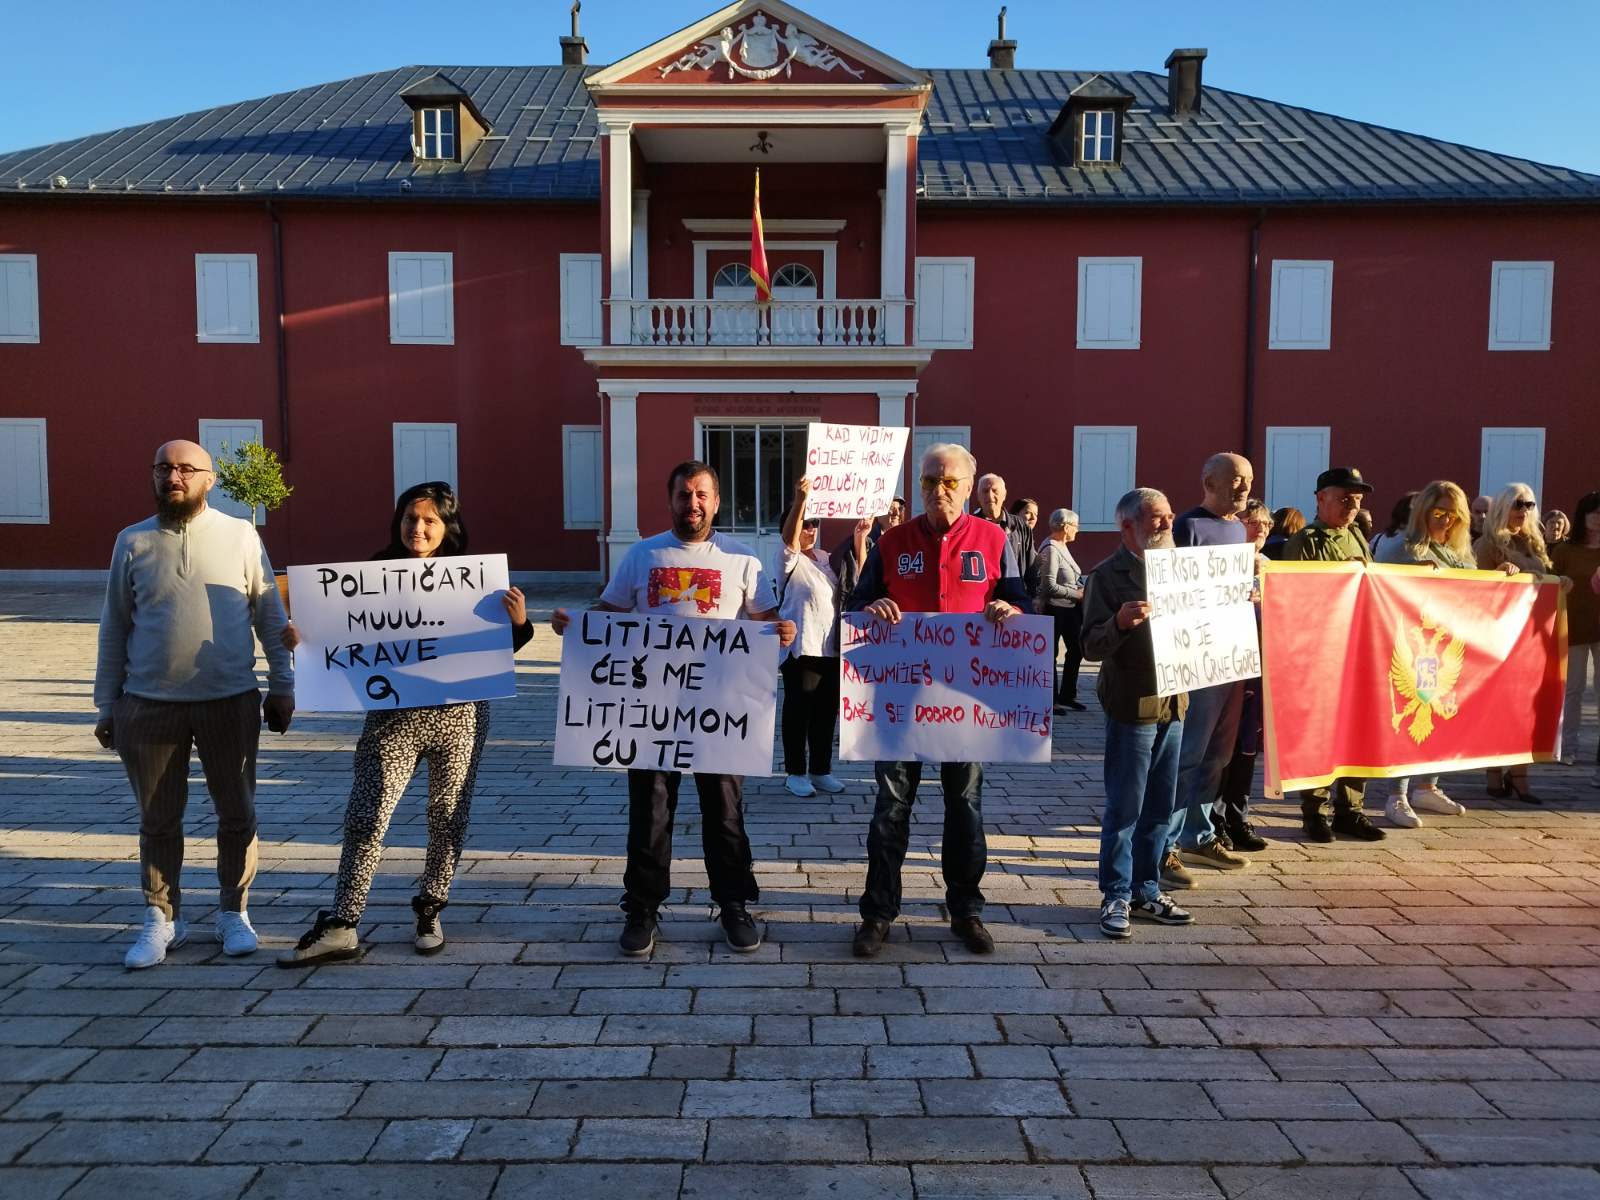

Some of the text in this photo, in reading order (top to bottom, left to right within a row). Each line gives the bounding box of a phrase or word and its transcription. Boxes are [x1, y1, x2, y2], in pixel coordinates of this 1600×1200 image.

[826, 426, 893, 445] KAD VIDIM
[808, 447, 895, 466] CIJENE HRANE
[812, 472, 885, 494] ODLUČIM DA
[317, 561, 485, 598] POLITIČARI
[897, 551, 924, 575] 94
[960, 550, 988, 583] D
[1170, 549, 1200, 583] RISTO
[1207, 550, 1227, 579] ŠTO
[1232, 552, 1249, 575] MU
[347, 607, 445, 633] MUUU...
[582, 612, 750, 654] LITIJAMA
[914, 618, 955, 647] KAKO
[965, 621, 984, 647] SE
[991, 621, 1047, 655] DOBRO
[1173, 620, 1213, 650] NO JE
[325, 637, 440, 671] KRAVE
[1156, 645, 1260, 695] DEMON CRNE GORE
[590, 653, 706, 691] ĆEŠ ME
[842, 656, 1053, 689] RAZUMIJEŠ U SPOMENIKE
[564, 695, 748, 741] LITIJUMOM
[842, 697, 1051, 737] BAŠ SE DOBRO RAZUMIJEŠ
[592, 729, 694, 768] ĆU TE
